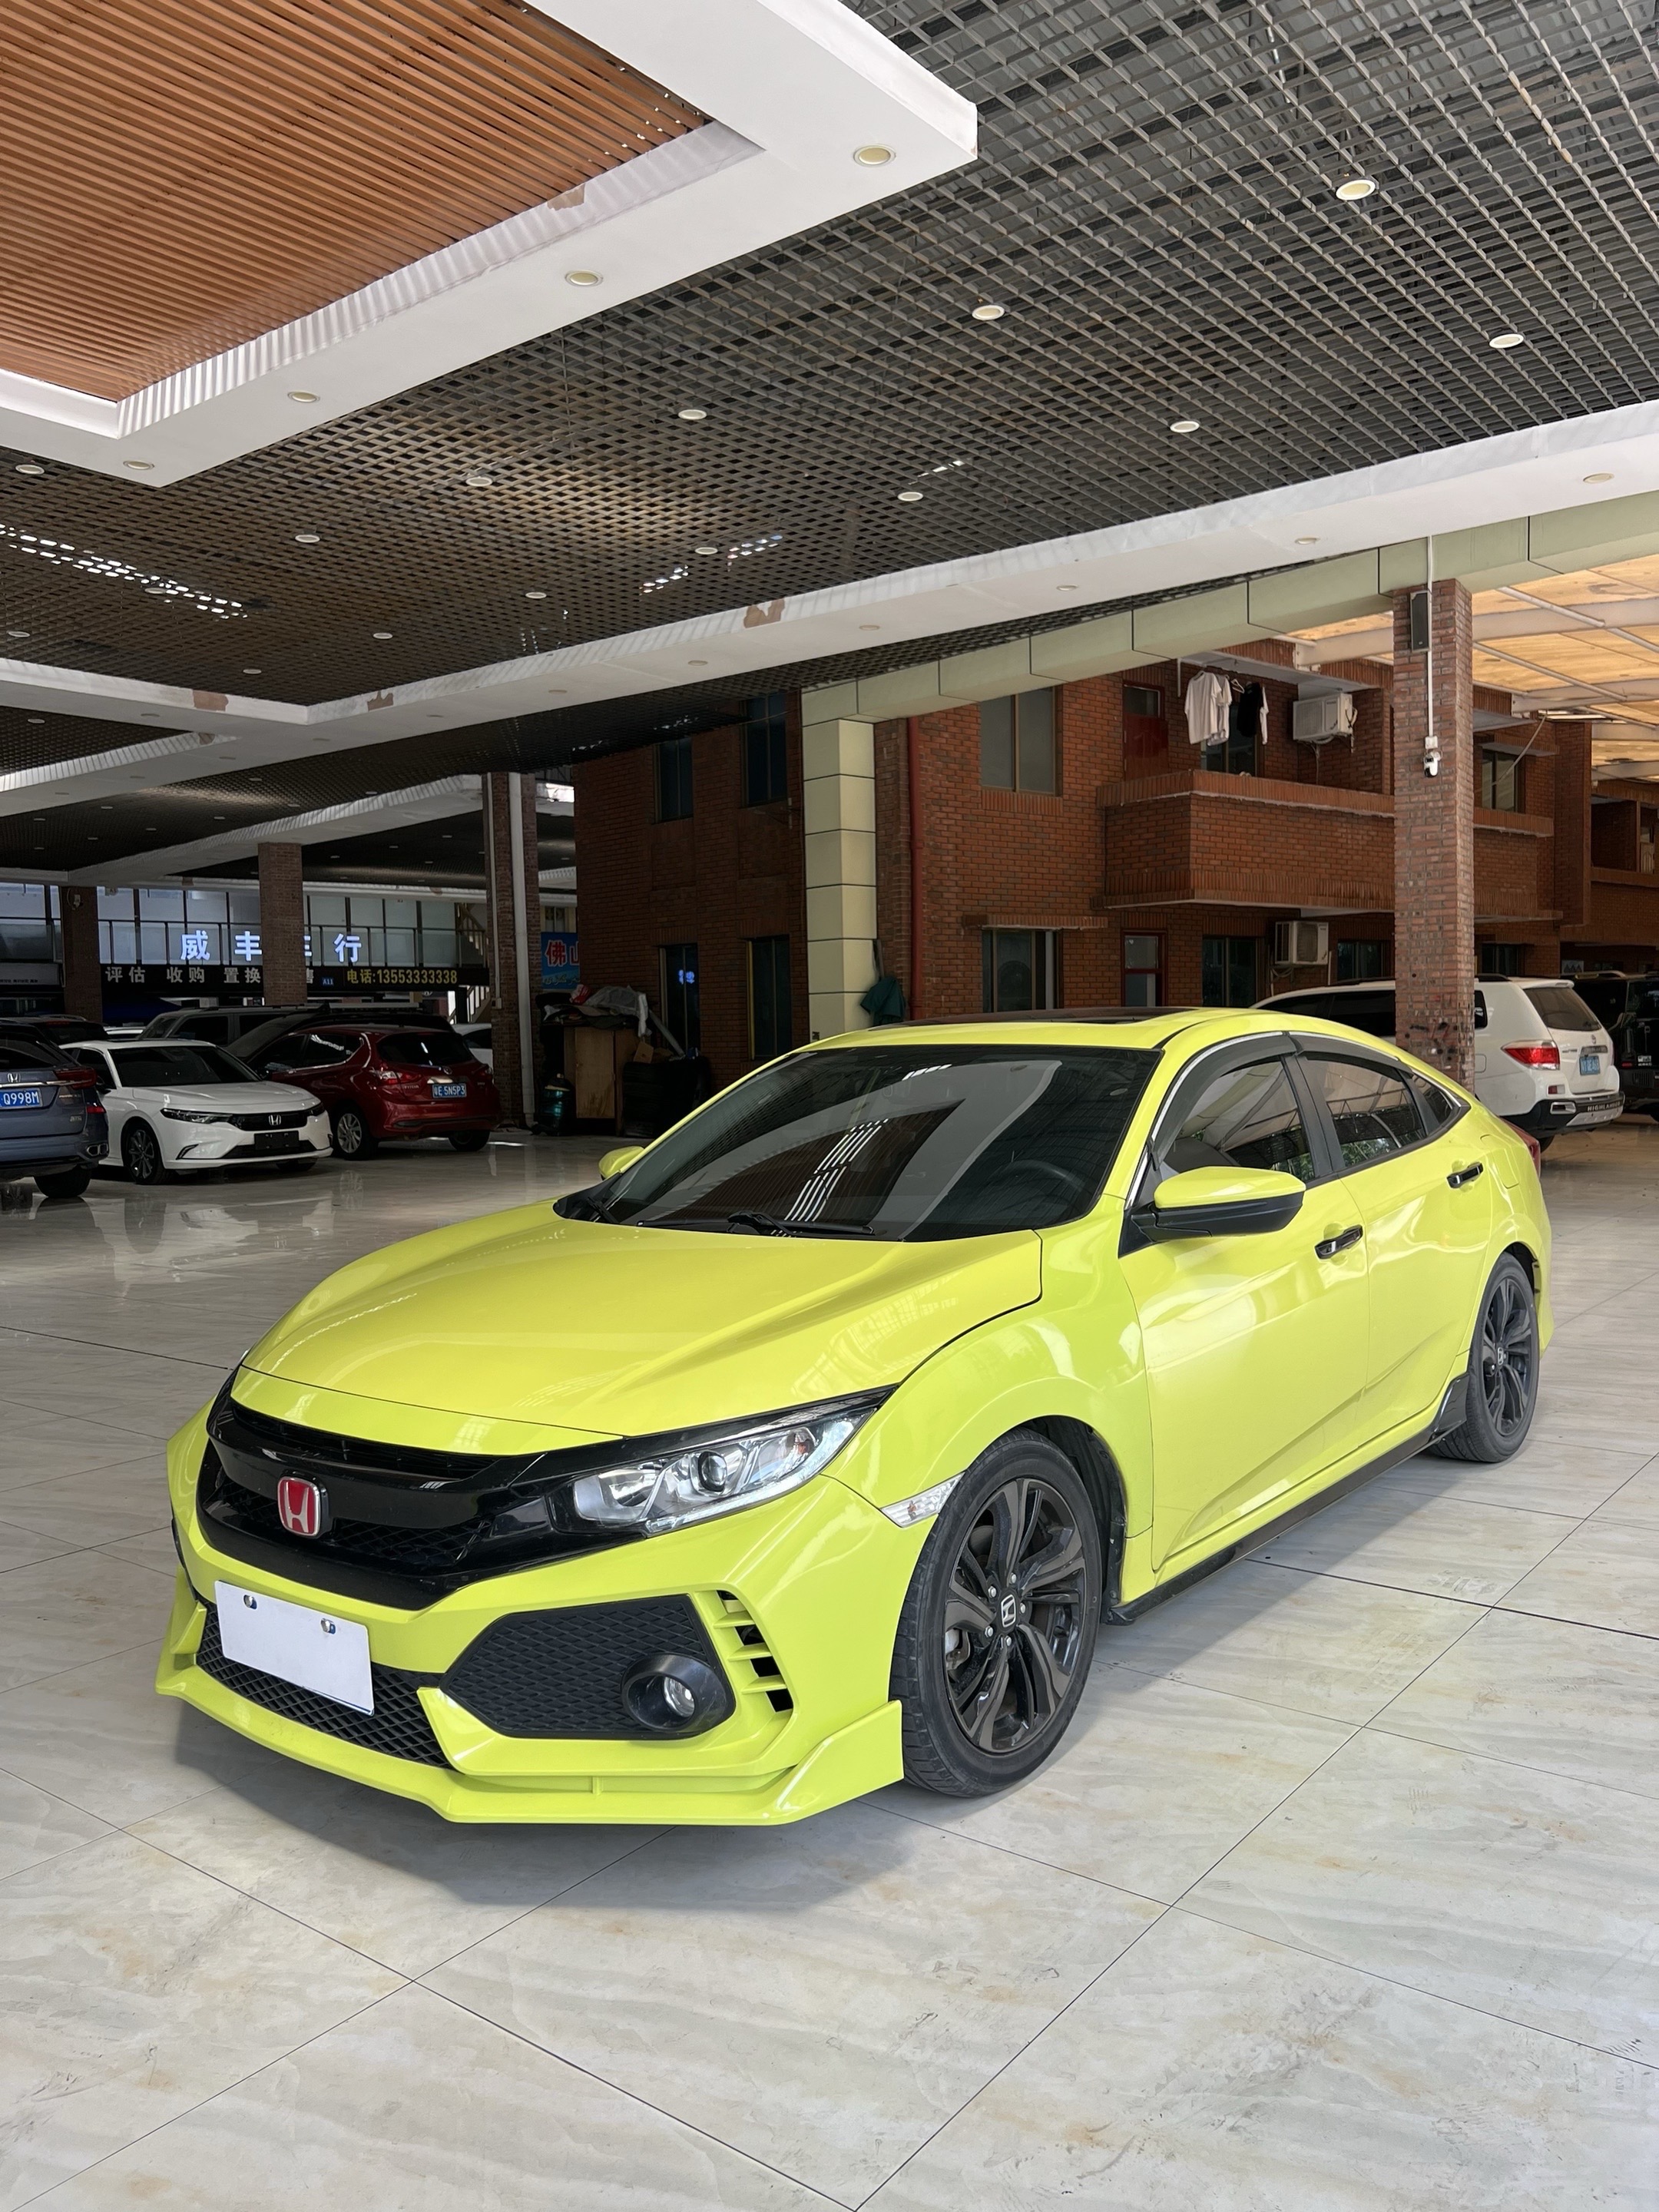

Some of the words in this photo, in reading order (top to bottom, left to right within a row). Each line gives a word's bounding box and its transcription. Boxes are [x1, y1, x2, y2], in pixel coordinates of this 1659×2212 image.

[180, 930, 362, 963] 威丰行
[104, 966, 145, 984] 评估
[166, 967, 205, 984] 收购
[224, 967, 261, 984] 置换
[346, 969, 458, 985] 电话:13553333338
